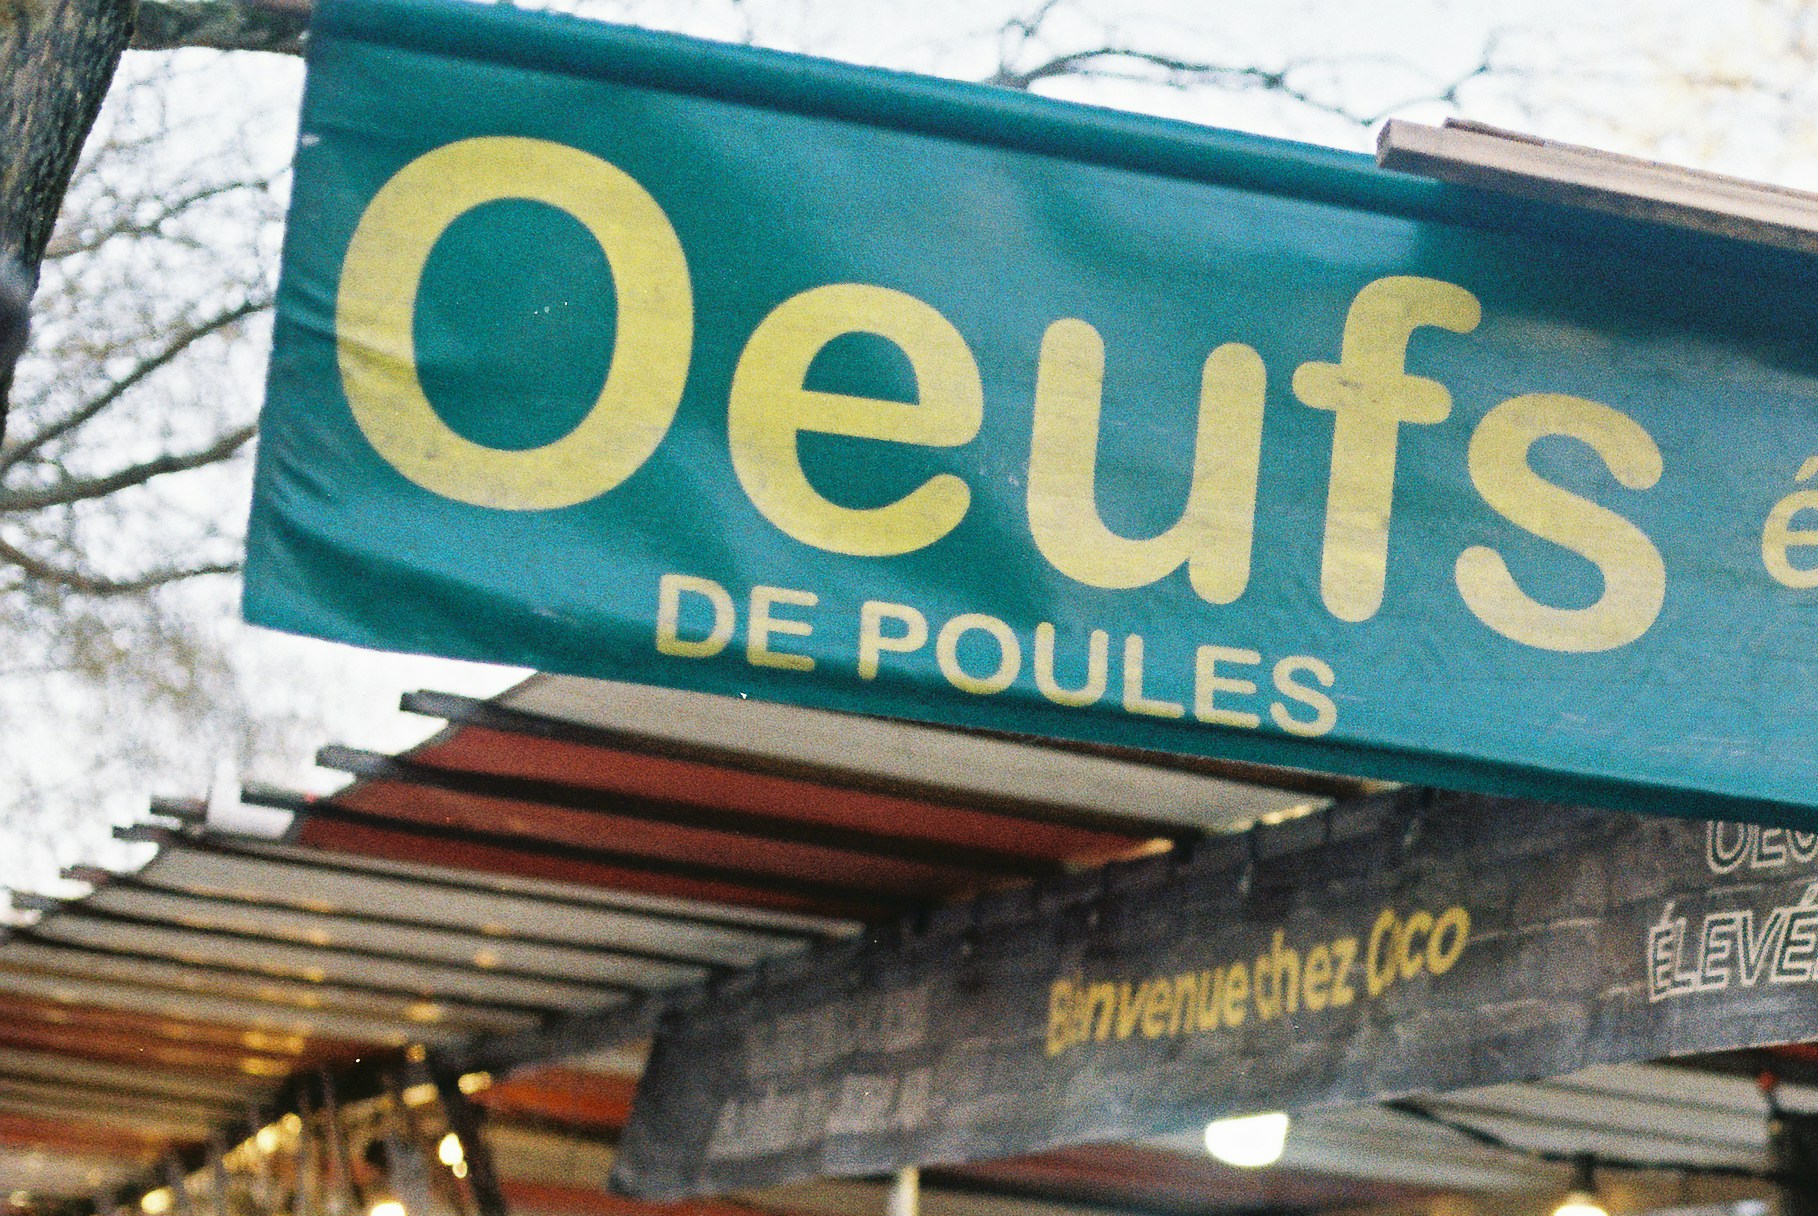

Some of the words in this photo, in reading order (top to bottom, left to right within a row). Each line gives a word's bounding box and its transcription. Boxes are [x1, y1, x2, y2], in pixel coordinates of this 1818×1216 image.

[336, 136, 1667, 652] Oeufs
[656, 574, 819, 673] DE
[857, 600, 1336, 738] POULES
